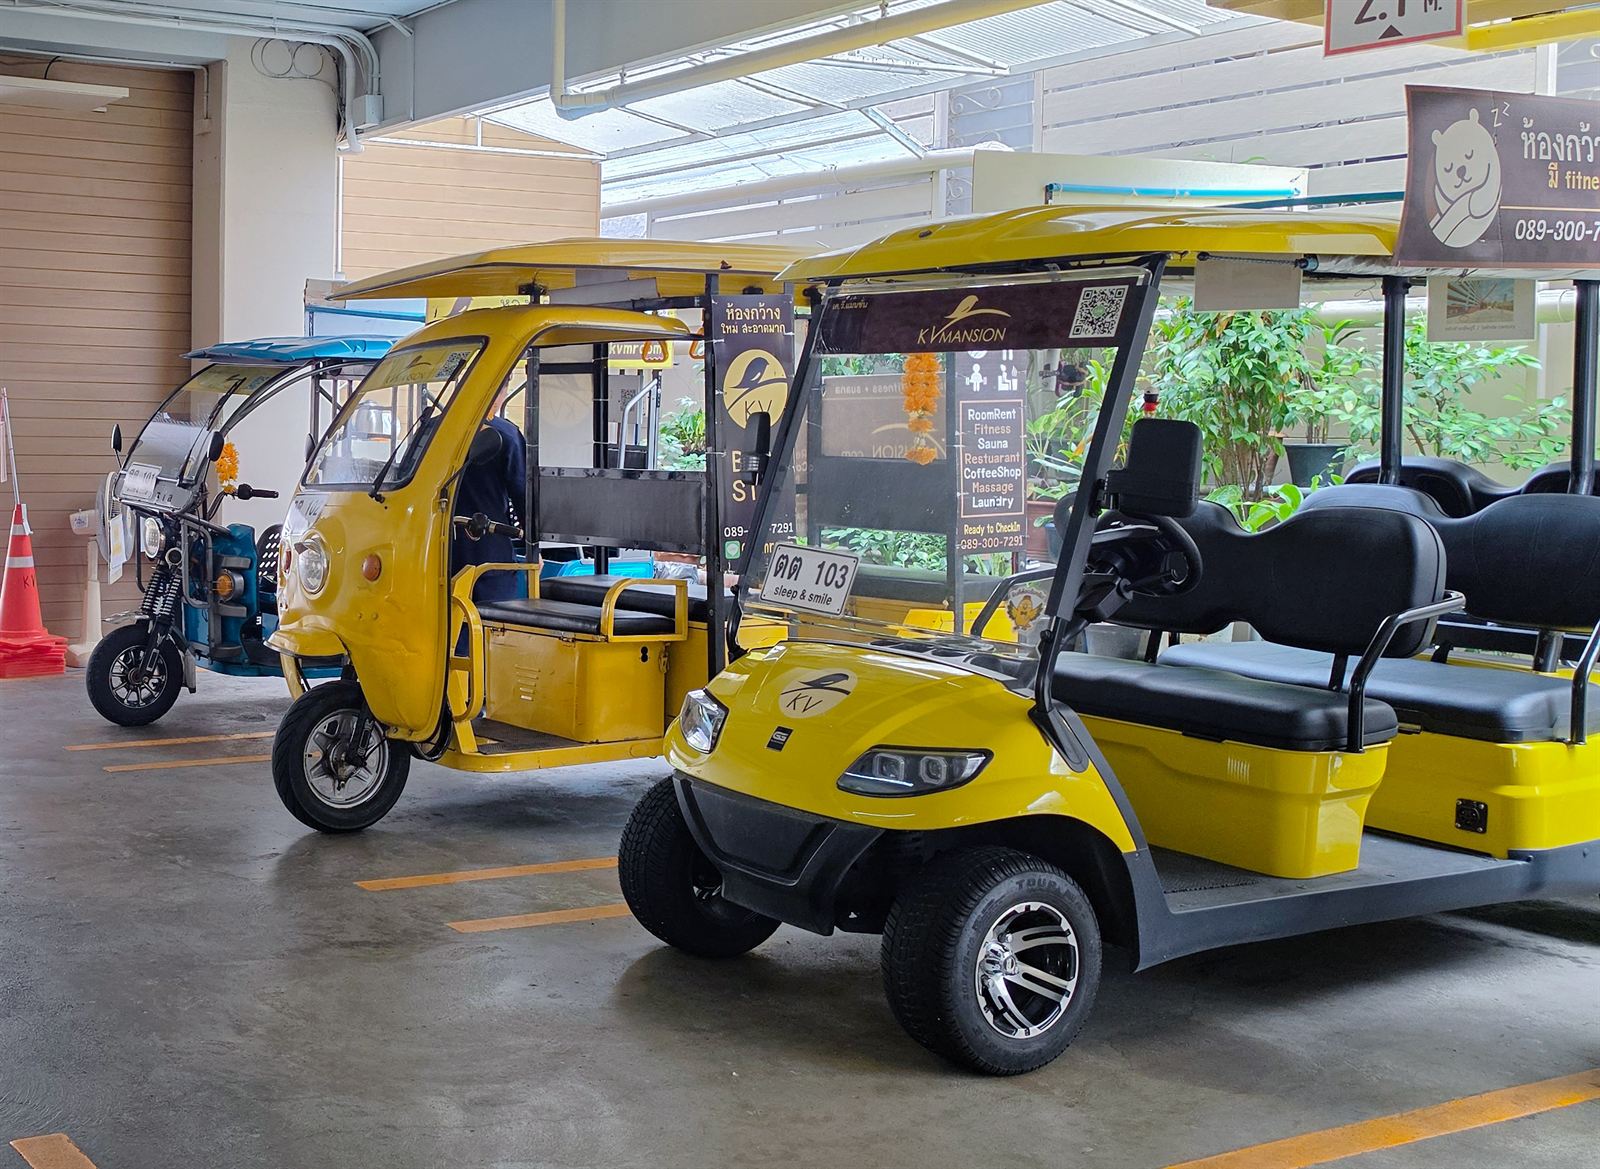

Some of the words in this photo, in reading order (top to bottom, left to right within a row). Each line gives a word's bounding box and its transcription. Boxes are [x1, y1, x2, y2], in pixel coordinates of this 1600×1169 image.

[1548, 162, 1558, 188] มี
[726, 302, 781, 320] ห้องกว้าง
[721, 322, 739, 334] ใหม่
[968, 408, 1017, 421] RoomRent
[974, 424, 1011, 435] Fitness
[978, 438, 1009, 450] Sauna
[965, 452, 1021, 465] Restuarant
[964, 466, 1022, 480] CoffeeShop
[972, 482, 1014, 494] Massage
[972, 496, 1014, 509] Laundry
[964, 524, 985, 536] Ready
[987, 523, 994, 533] to
[961, 536, 1023, 550] 089-300-7291
[815, 560, 849, 589] 103
[774, 585, 798, 600] sleep
[800, 589, 807, 600] &
[808, 593, 832, 606] smile
[786, 693, 823, 713] KV
